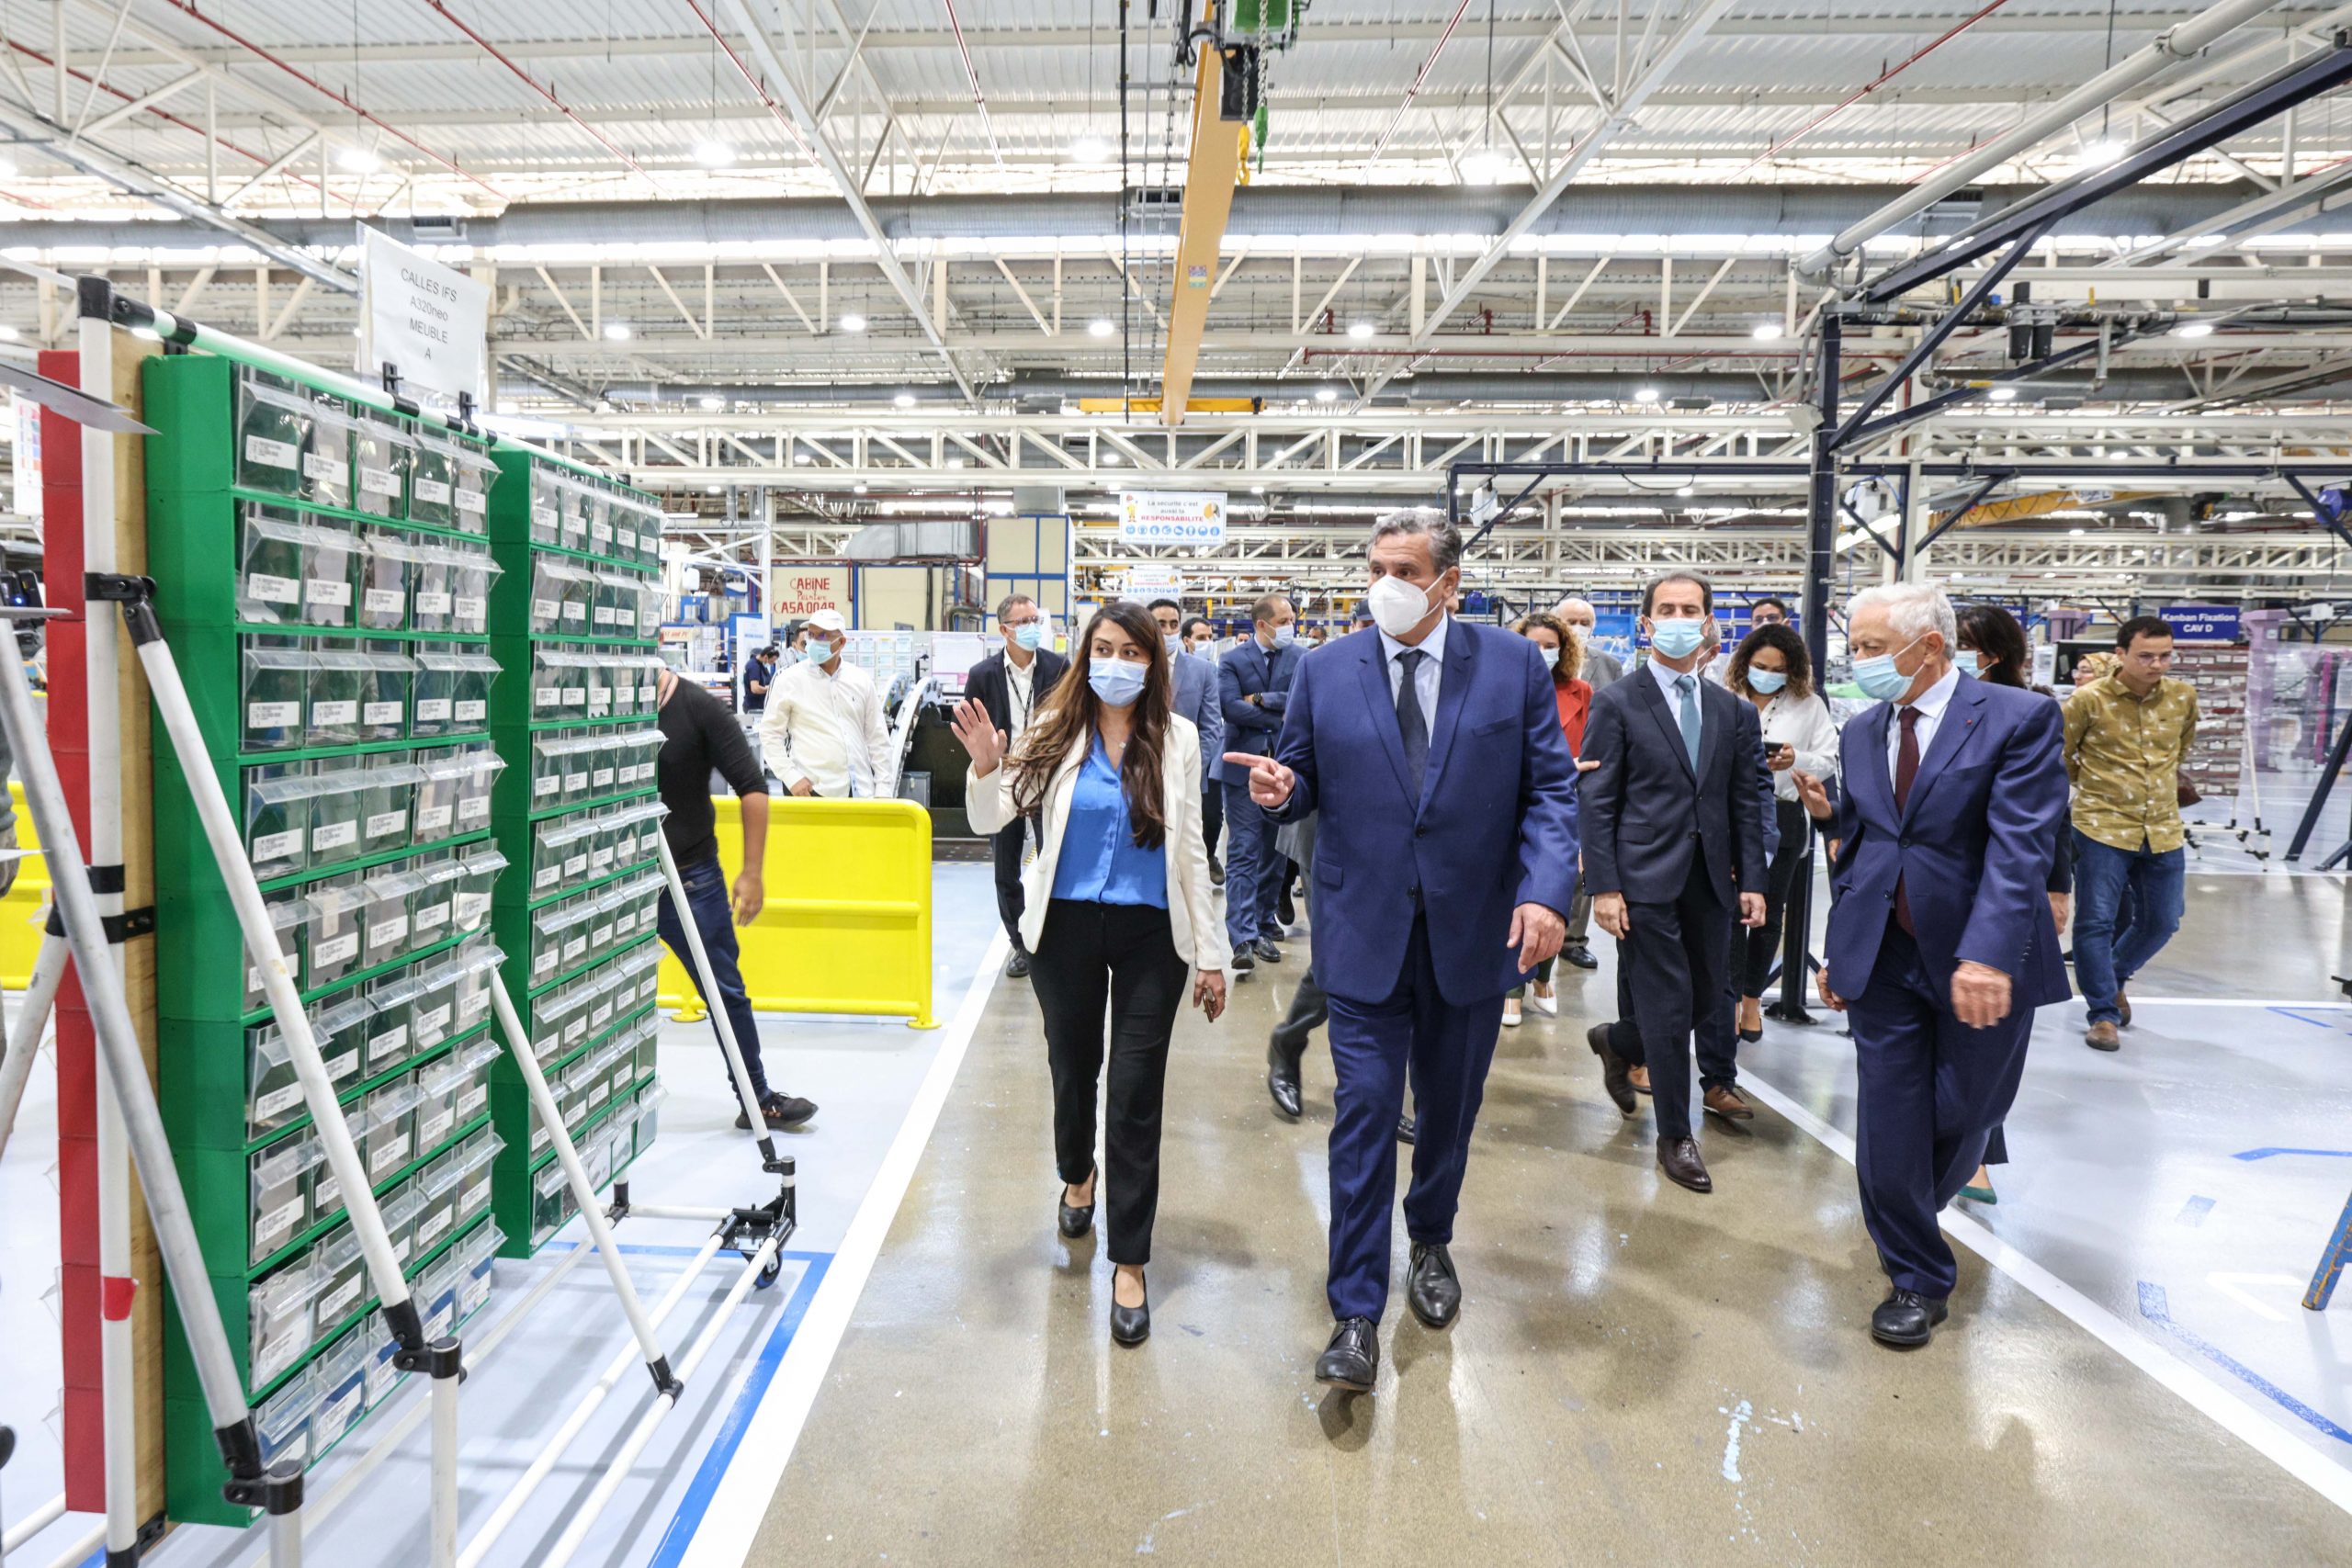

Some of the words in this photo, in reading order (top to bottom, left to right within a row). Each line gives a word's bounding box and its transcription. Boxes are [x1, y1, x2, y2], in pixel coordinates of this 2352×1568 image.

[401, 267, 439, 295] CALLES
[442, 286, 458, 302] IFS
[410, 295, 448, 321] A320neo
[409, 318, 448, 344] MEUBLE
[424, 347, 432, 360] A
[2161, 613, 2197, 622] Kanban
[2199, 613, 2236, 622] Fixation
[2183, 624, 2205, 633] CAV
[2205, 624, 2213, 633] D
